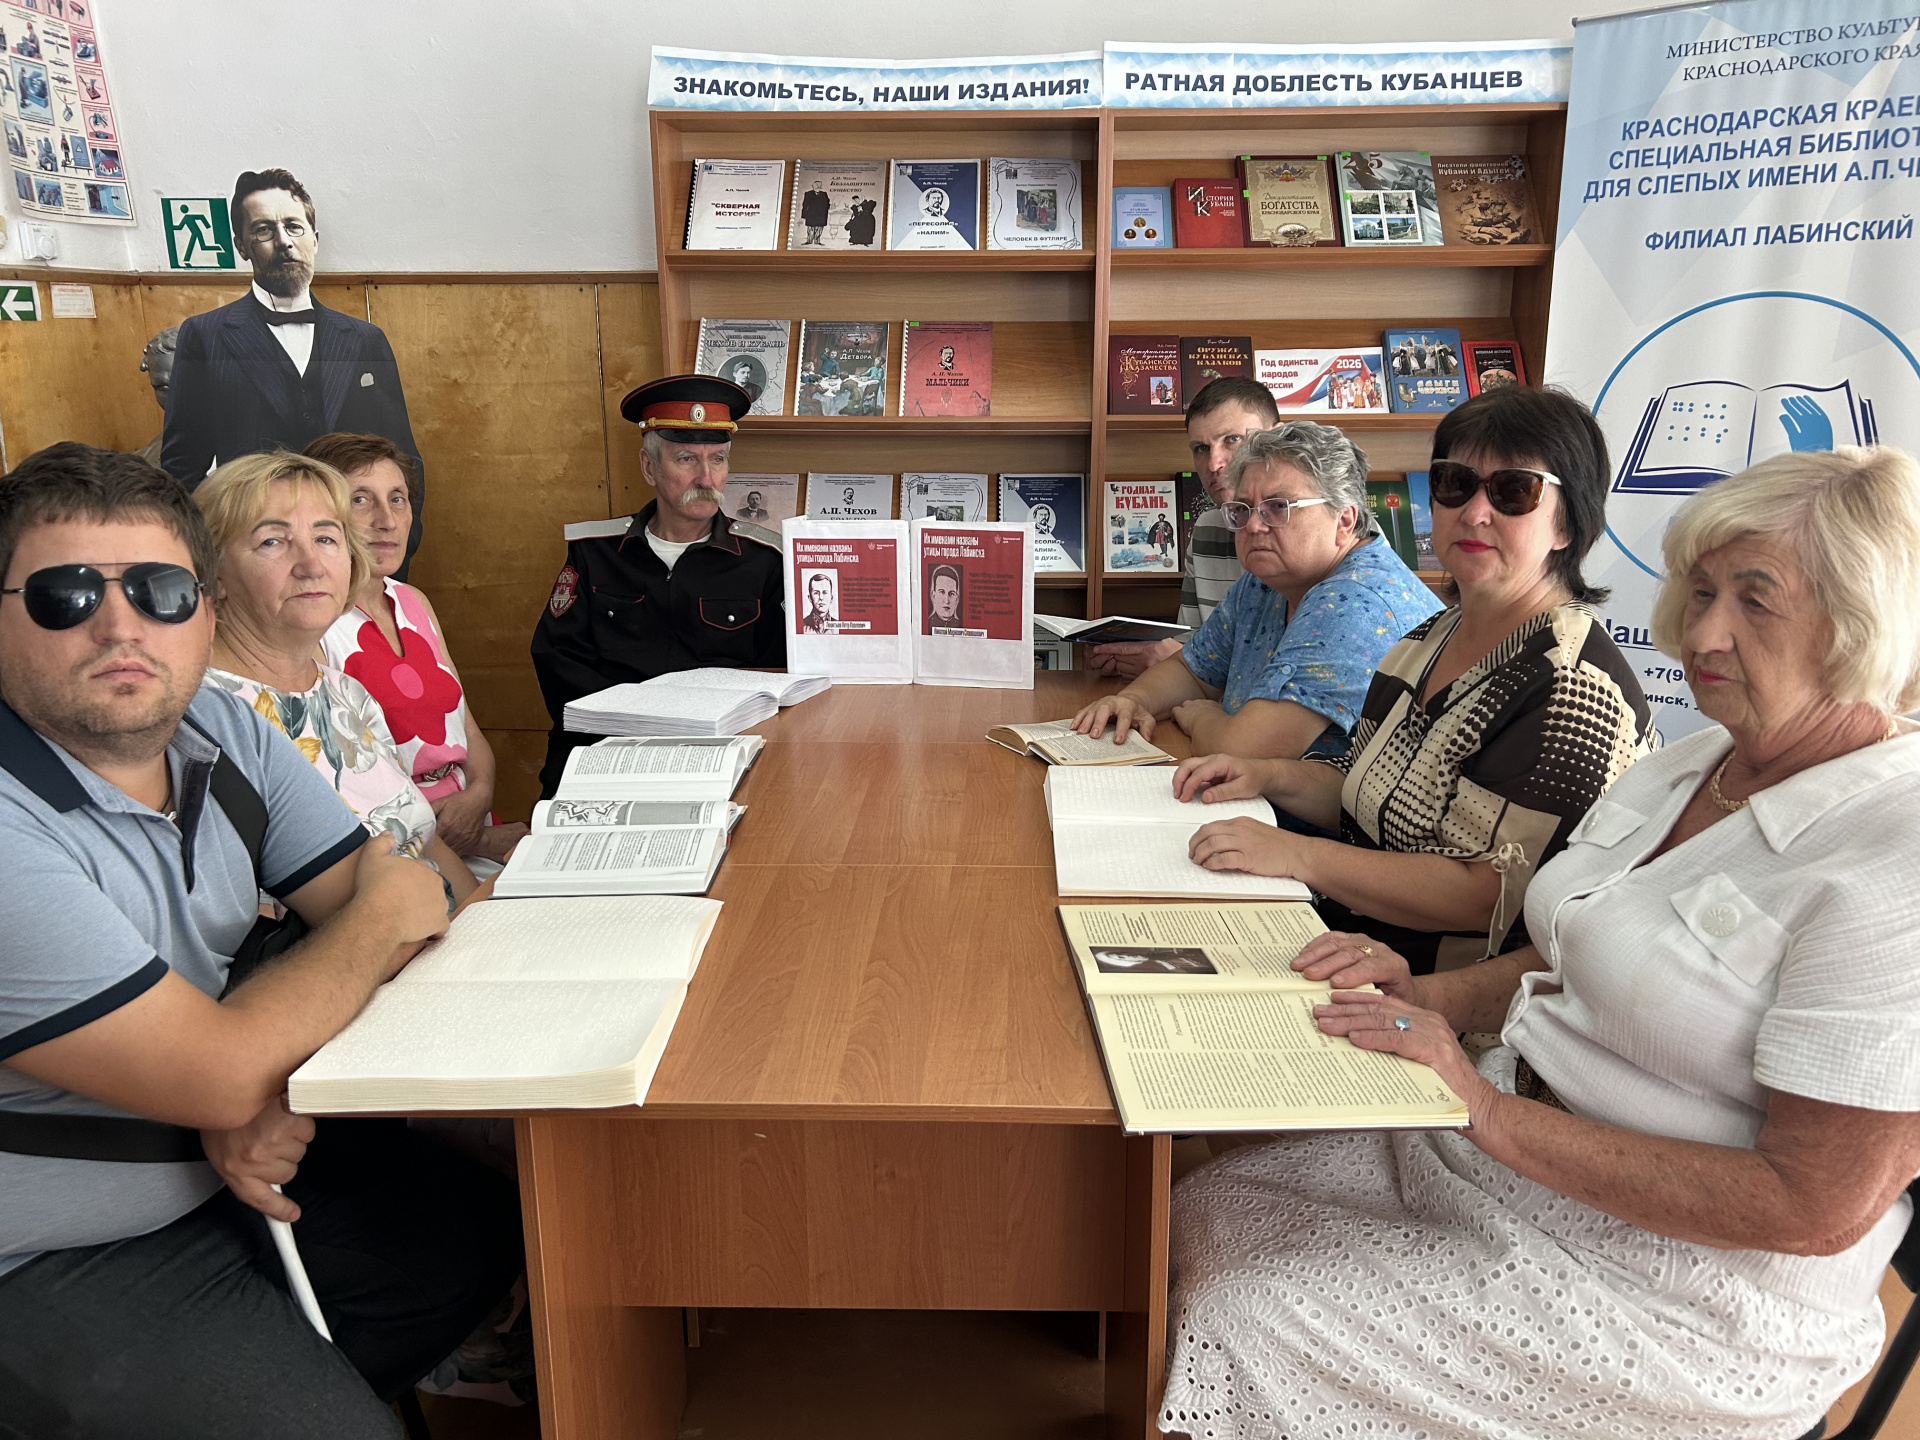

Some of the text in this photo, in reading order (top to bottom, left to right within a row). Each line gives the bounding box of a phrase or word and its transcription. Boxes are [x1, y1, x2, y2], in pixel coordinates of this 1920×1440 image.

[1666, 16, 1920, 59] МИНИСТЕРСТВО КУЛЬТУ
[1682, 48, 1868, 81] КРАСНОДАРСКОГО
[673, 76, 1090, 105] ЗНАКОМЬТЕСЬ, НАШИ ИЗДАНИЯ!
[1125, 70, 1523, 96] РАТНАЯ ДОБЛЕСТЬ КУБАНЦЕВ
[1621, 102, 1838, 141] КРАСНОДАРСКАЯ
[1608, 126, 1920, 170] СПЕЦИАЛЬНАЯ БИБЛИОТ
[1583, 178, 1631, 203] ДЛЯ
[1637, 169, 1740, 196] СЛЕПЫХ
[1747, 162, 1838, 188] ИМЕНИ
[1260, 201, 1319, 210] БОГАТСТВА
[1645, 214, 1914, 251] ФИЛИАЛ ЛАБИНСКИЙ
[1260, 359, 1319, 367] Год единства
[1336, 359, 1362, 368] 2026
[926, 378, 969, 386] МАЛЬЧИКИ
[1262, 370, 1299, 379] народов
[1121, 485, 1156, 494] РОДНАЯ
[1115, 496, 1169, 510] КУБАНЬ
[1643, 667, 1688, 684] +7(9
